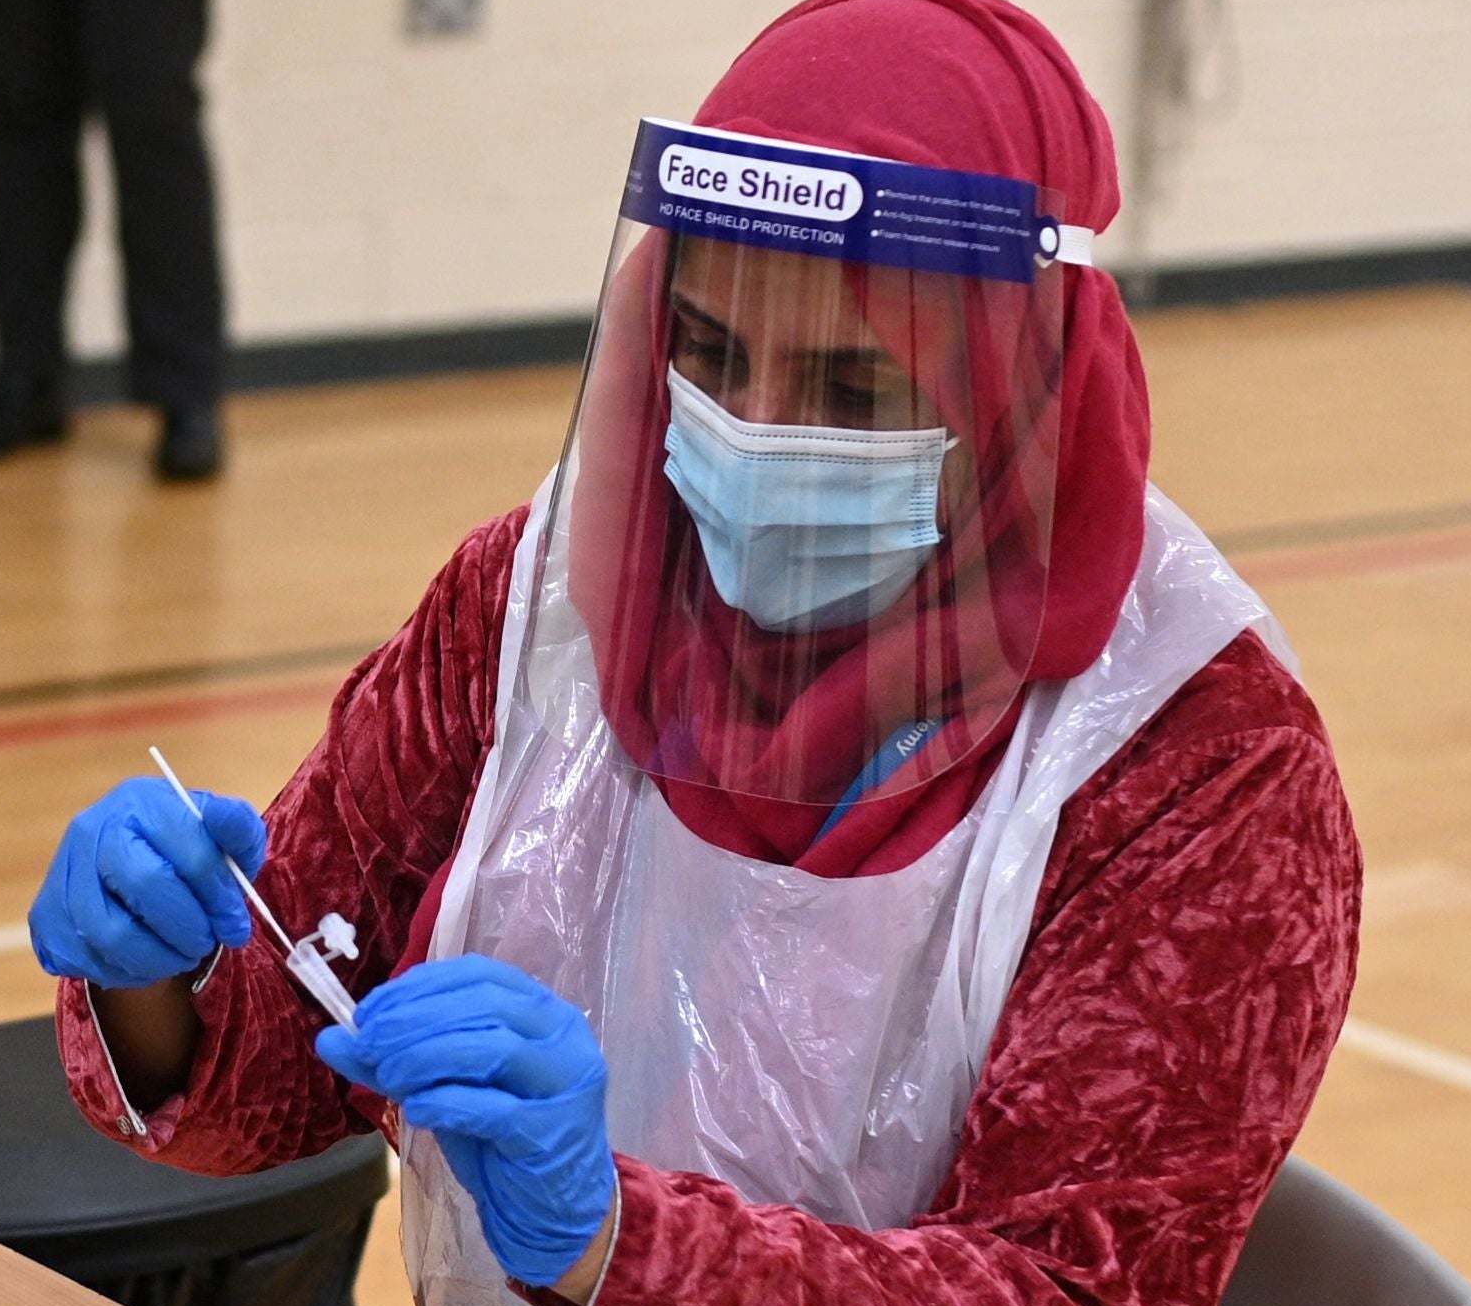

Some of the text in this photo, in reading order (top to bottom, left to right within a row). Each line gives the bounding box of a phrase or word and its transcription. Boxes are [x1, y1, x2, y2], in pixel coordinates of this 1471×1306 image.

[666, 154, 728, 192] Face
[738, 168, 847, 211] Shield
[659, 202, 845, 245] HD FACE SHIELD PROTECTION
